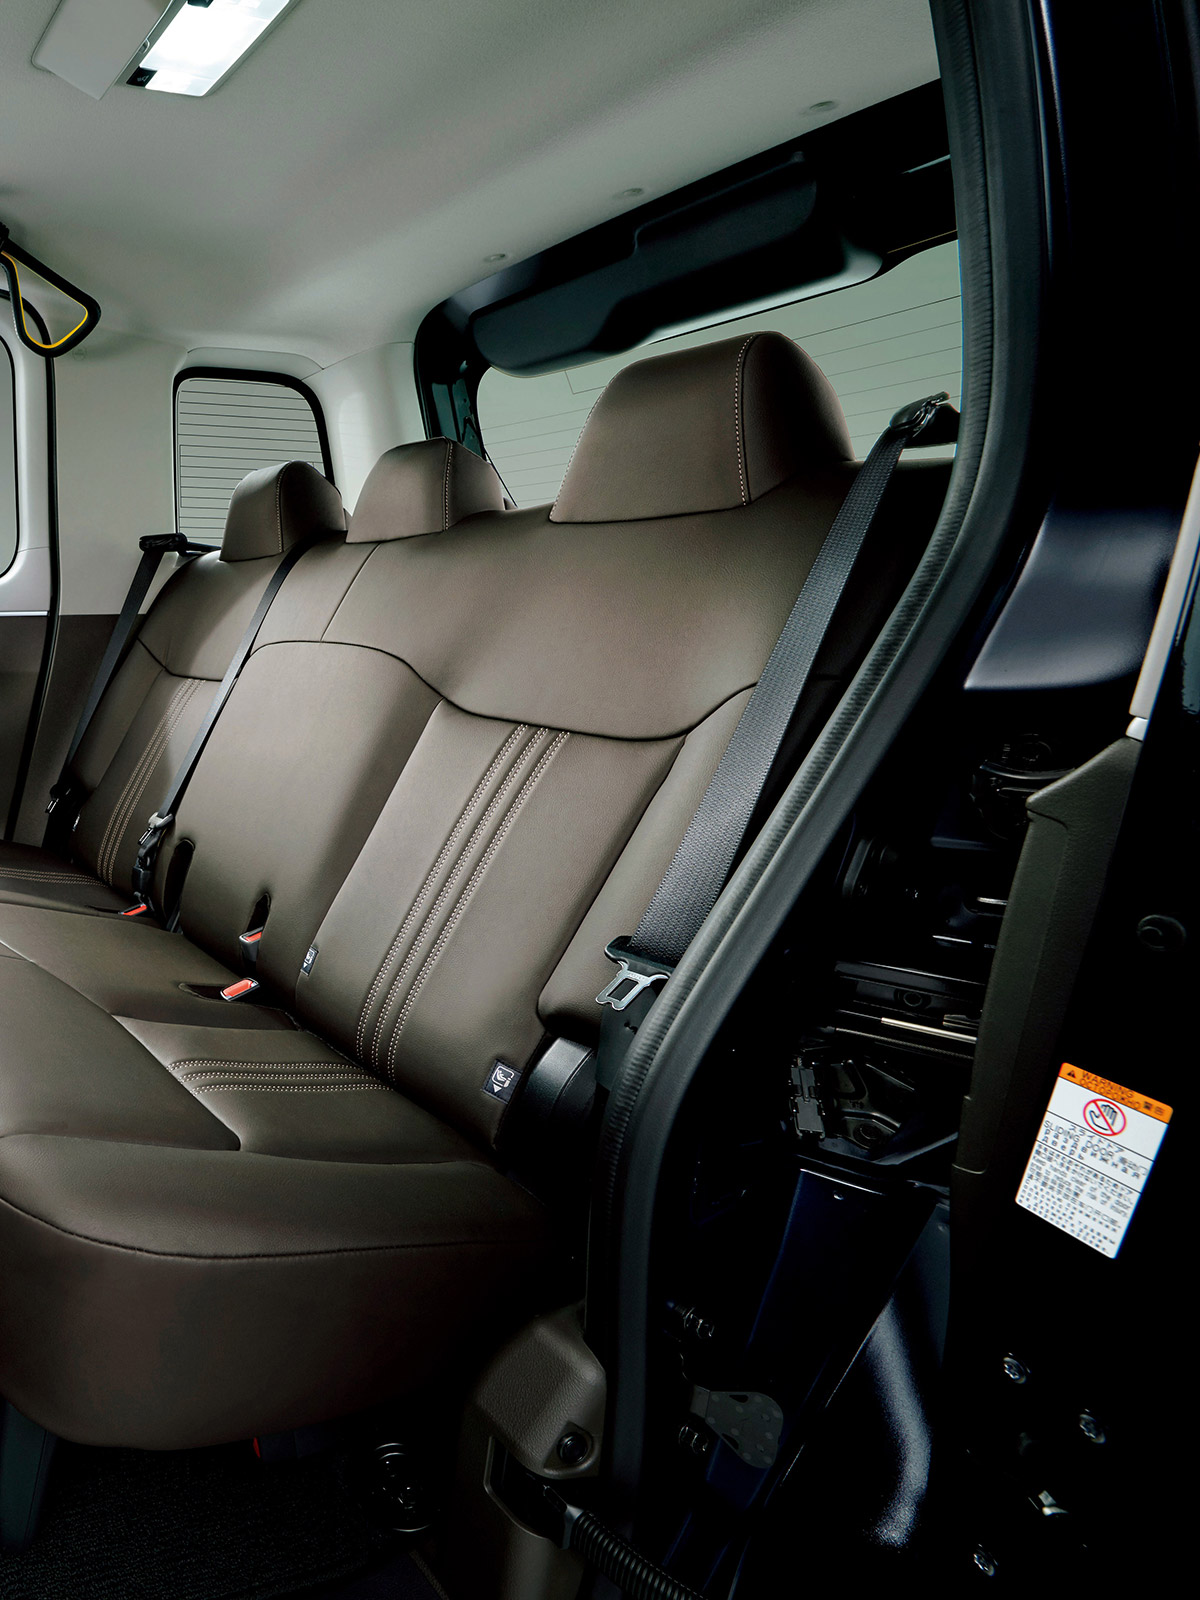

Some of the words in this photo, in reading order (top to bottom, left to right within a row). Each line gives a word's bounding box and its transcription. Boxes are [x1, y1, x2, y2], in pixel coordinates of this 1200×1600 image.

[1080, 1070, 1135, 1099] WARNING
[1043, 1119, 1081, 1143] SLIDING
[1085, 1139, 1115, 1159] DOOR
